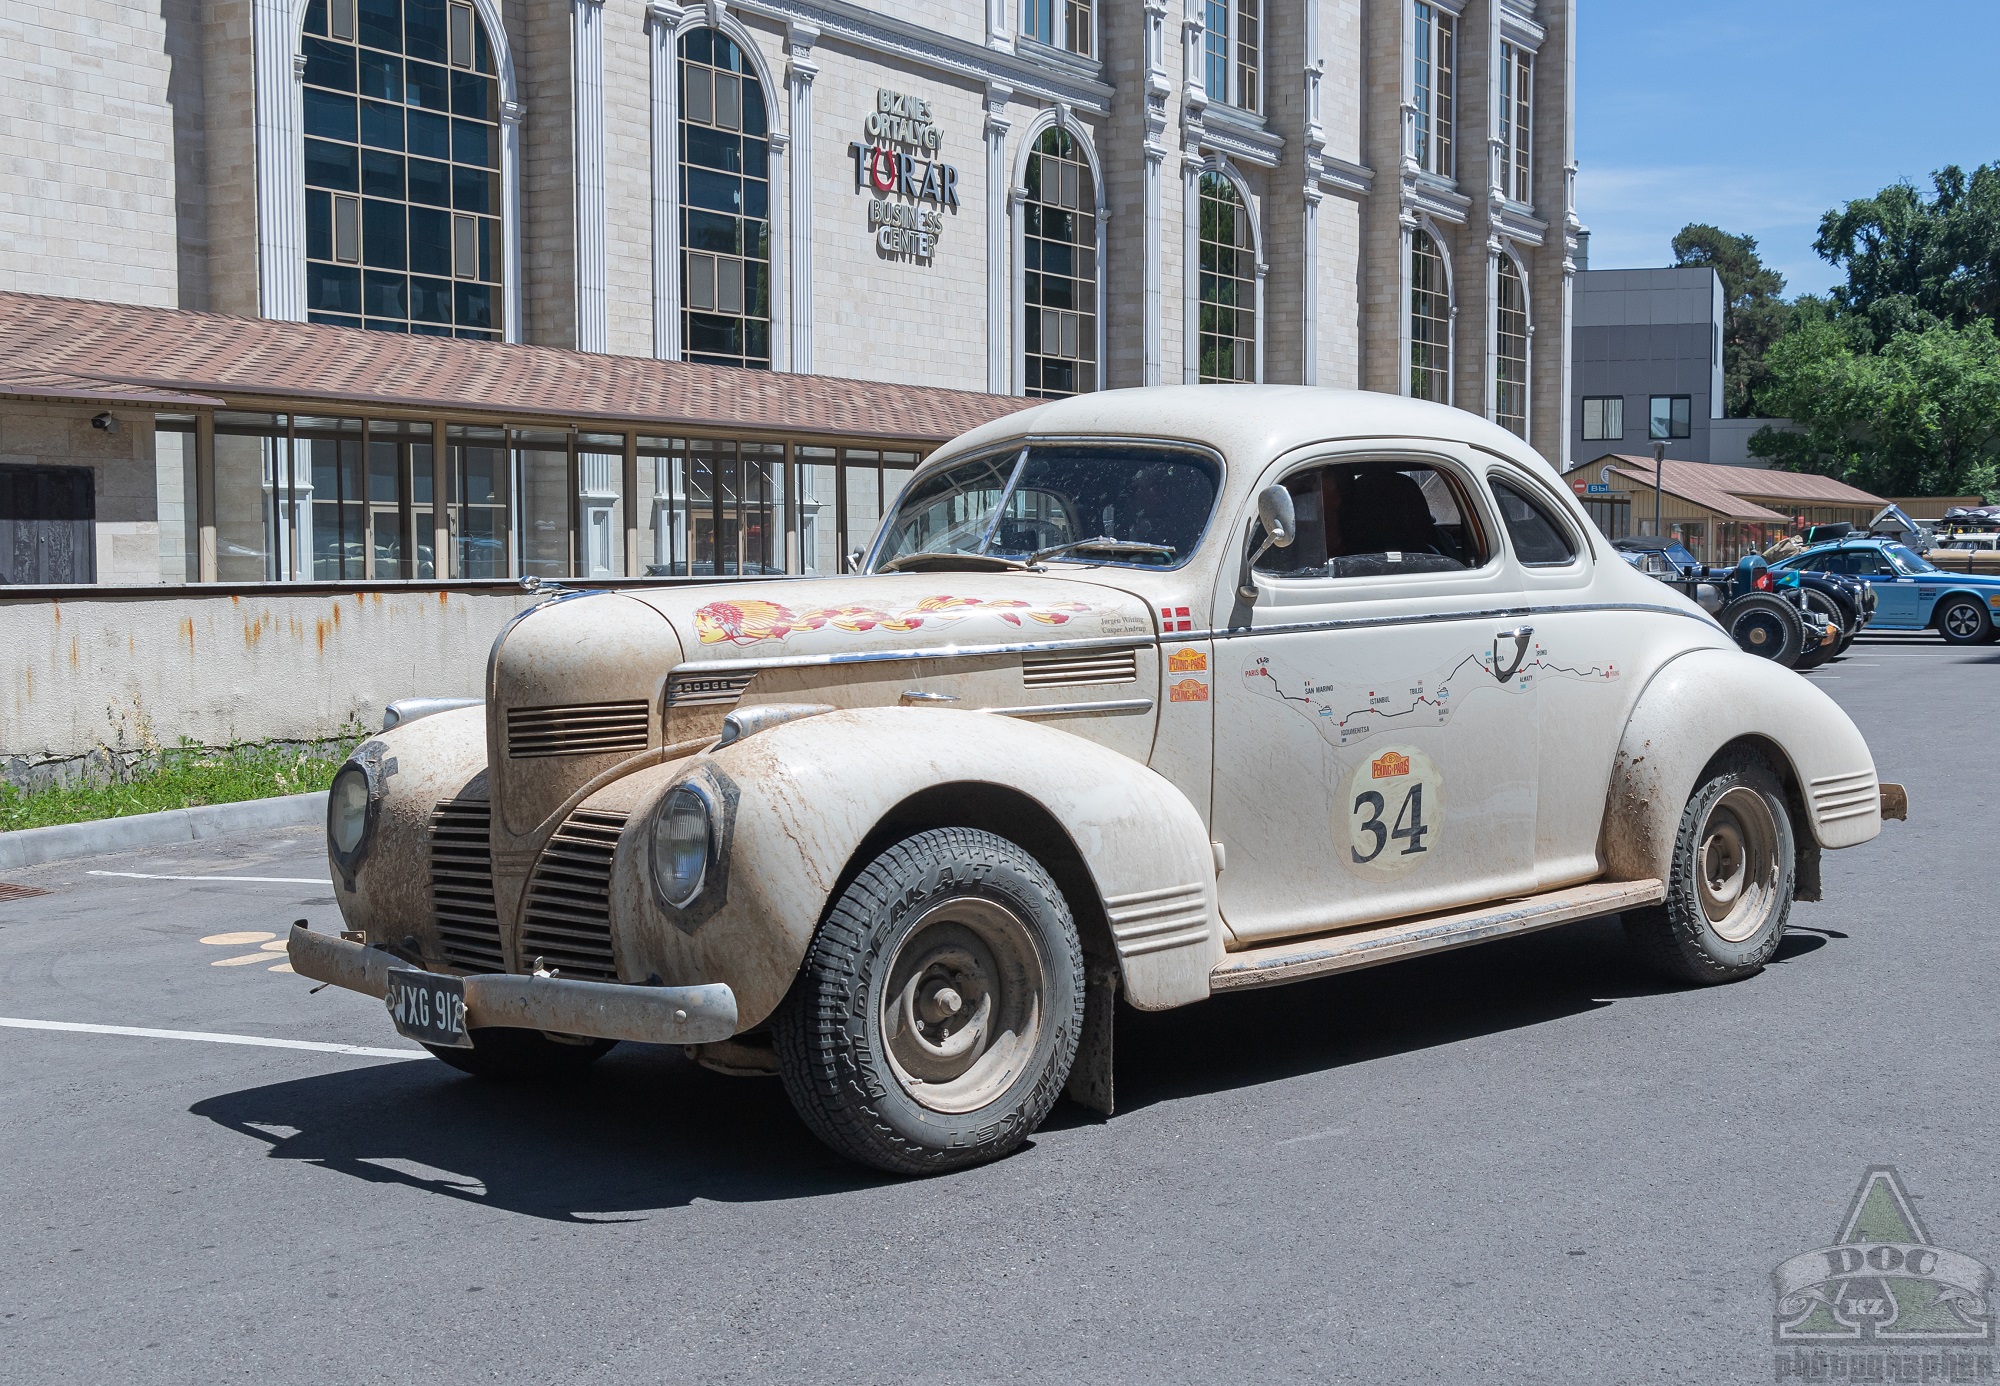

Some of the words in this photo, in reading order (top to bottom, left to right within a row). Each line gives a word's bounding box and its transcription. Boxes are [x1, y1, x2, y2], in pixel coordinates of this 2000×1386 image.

[877, 87, 933, 123] BIZNES
[848, 141, 961, 207] TURAR
[868, 199, 943, 235] BUSINESS
[876, 225, 936, 258] CENTER
[684, 681, 728, 691] DODGE
[1245, 669, 1260, 677] PARIS
[1304, 687, 1315, 695] SAN
[1315, 684, 1334, 694] MARINO
[1369, 696, 1391, 705] ISTANBUL
[1409, 687, 1424, 695] TBILISI
[1373, 762, 1391, 777] PEKING
[1393, 760, 1409, 775] PARIS
[1351, 783, 1428, 864] 34
[853, 875, 928, 1098] WILDPEAK
[435, 990, 464, 1033] 912
